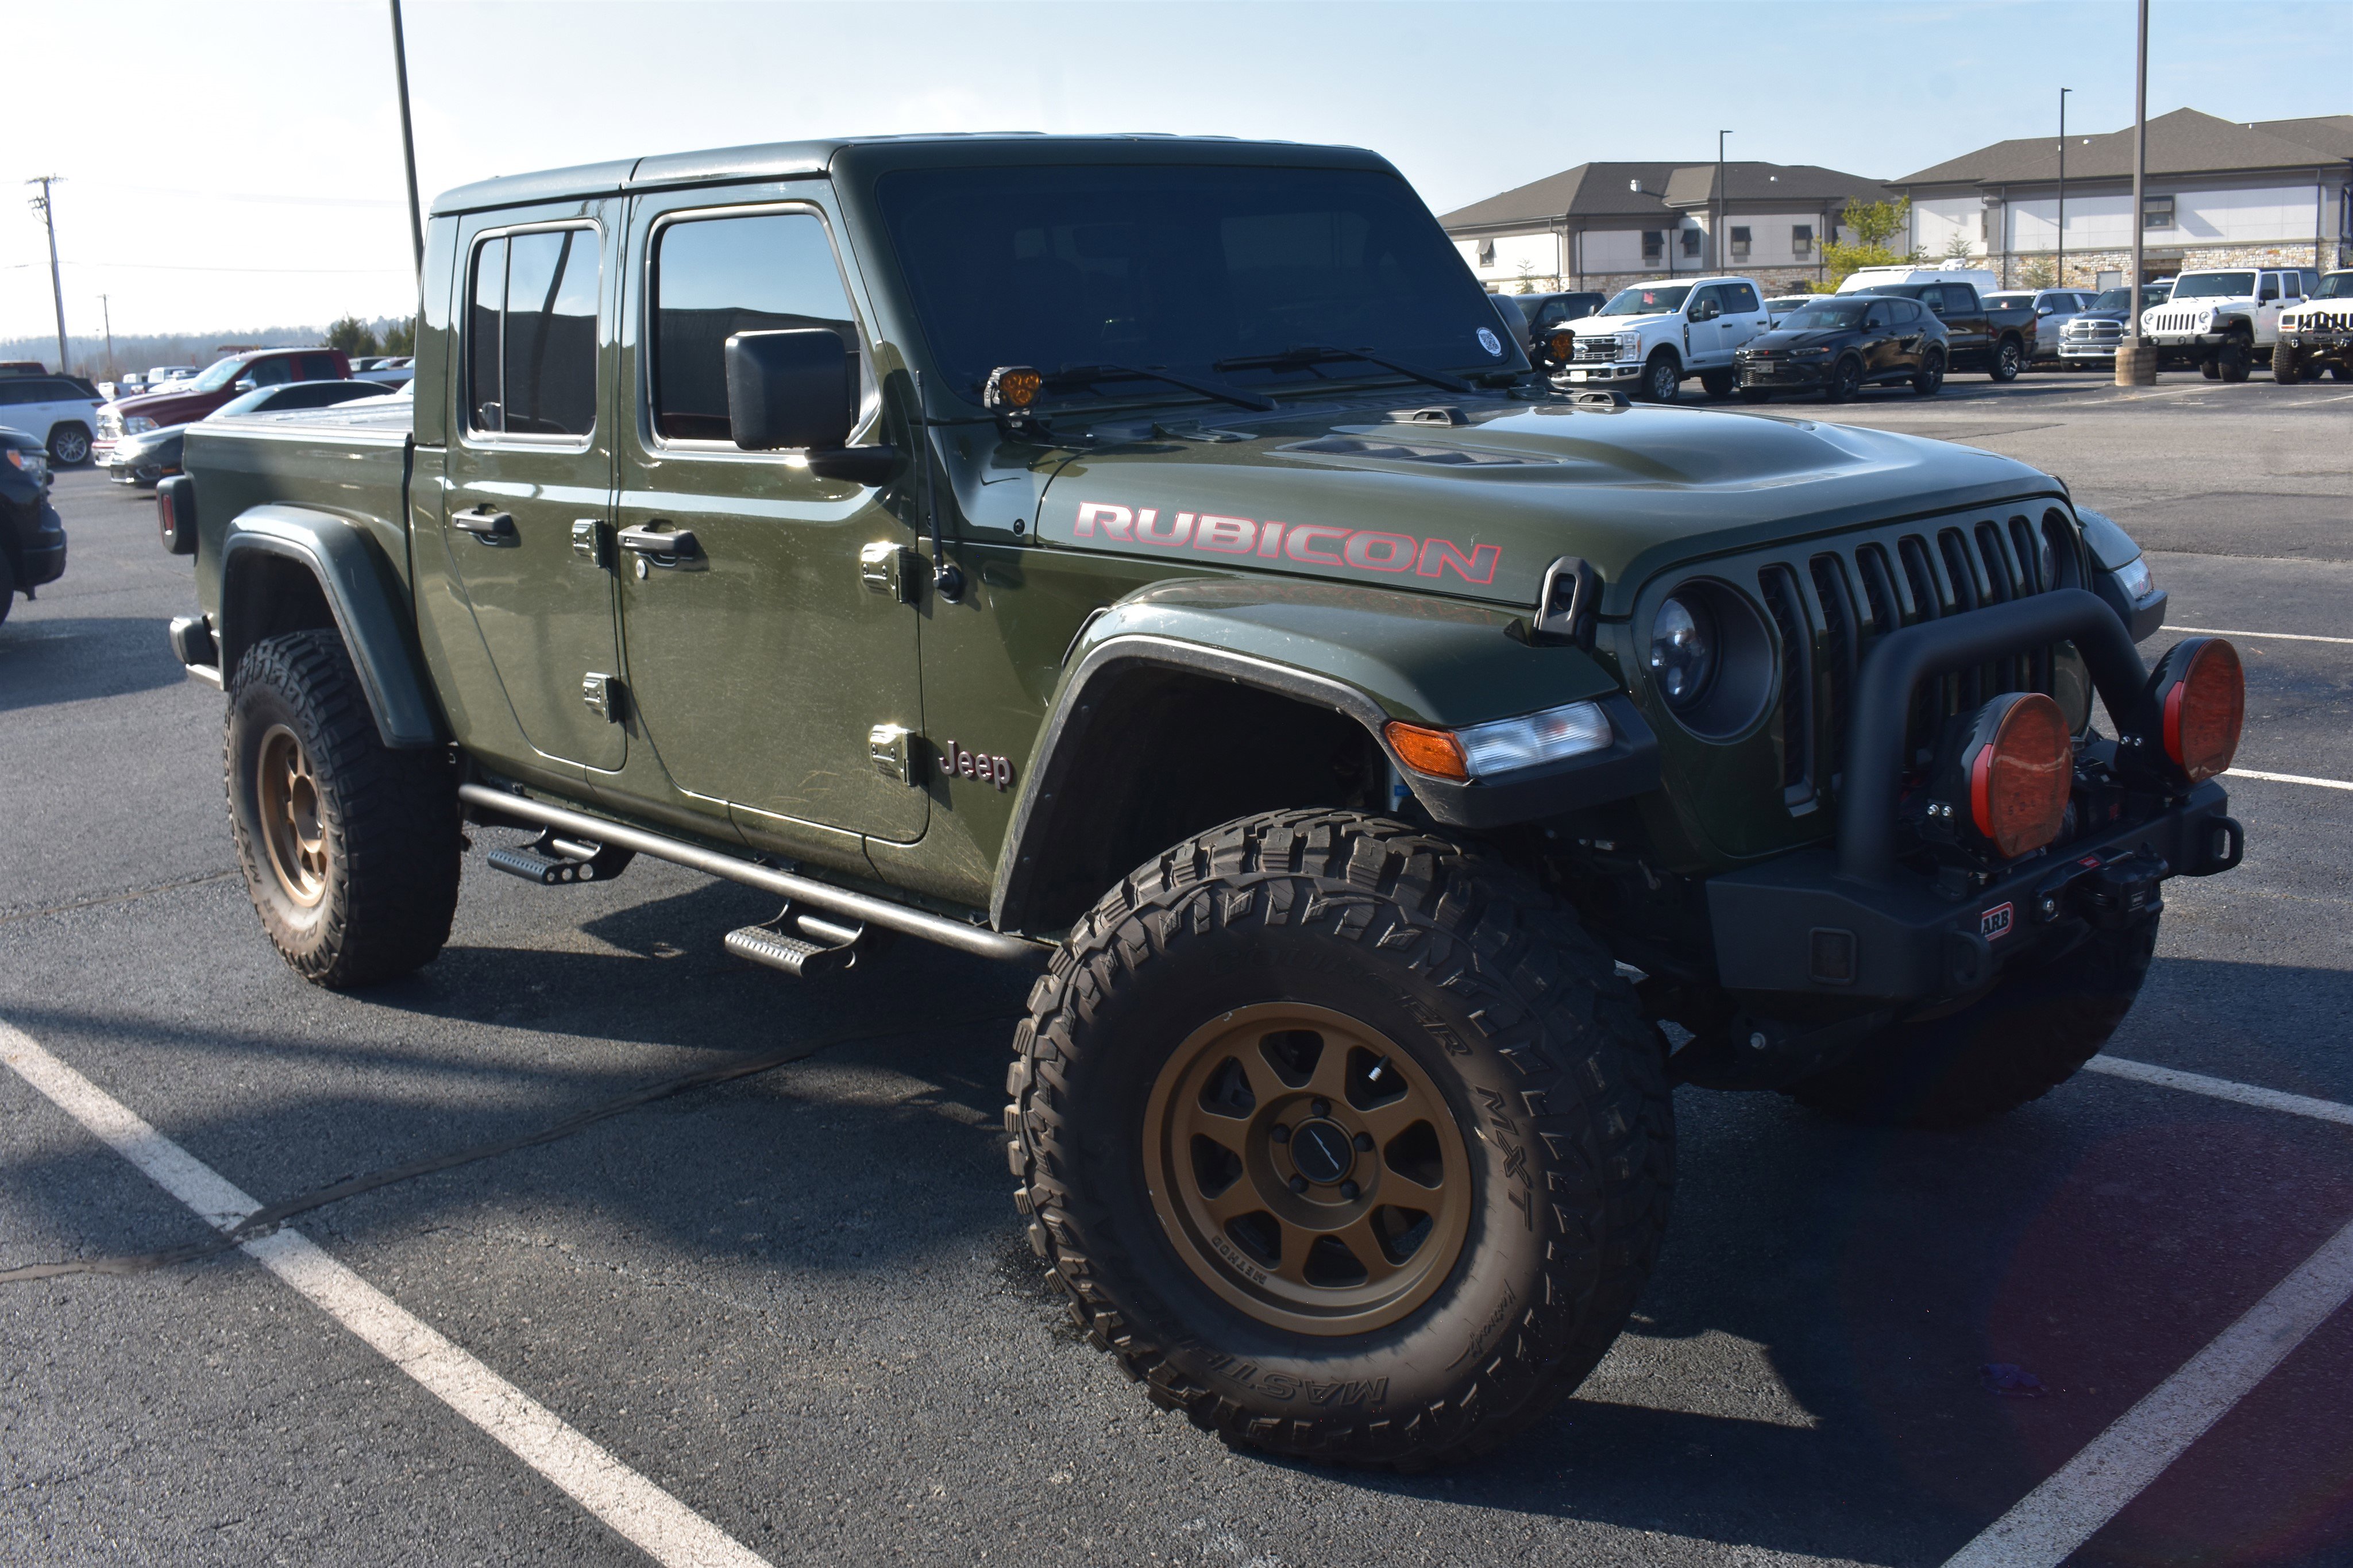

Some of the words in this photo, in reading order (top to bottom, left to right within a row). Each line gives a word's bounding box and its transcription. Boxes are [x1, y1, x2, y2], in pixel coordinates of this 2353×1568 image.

[1074, 501, 1502, 584] RUBICON
[938, 739, 1013, 791] Jeep
[1981, 909, 2009, 937] ARB
[1475, 1086, 1535, 1231] MXT
[1212, 1235, 1267, 1285] METHOD
